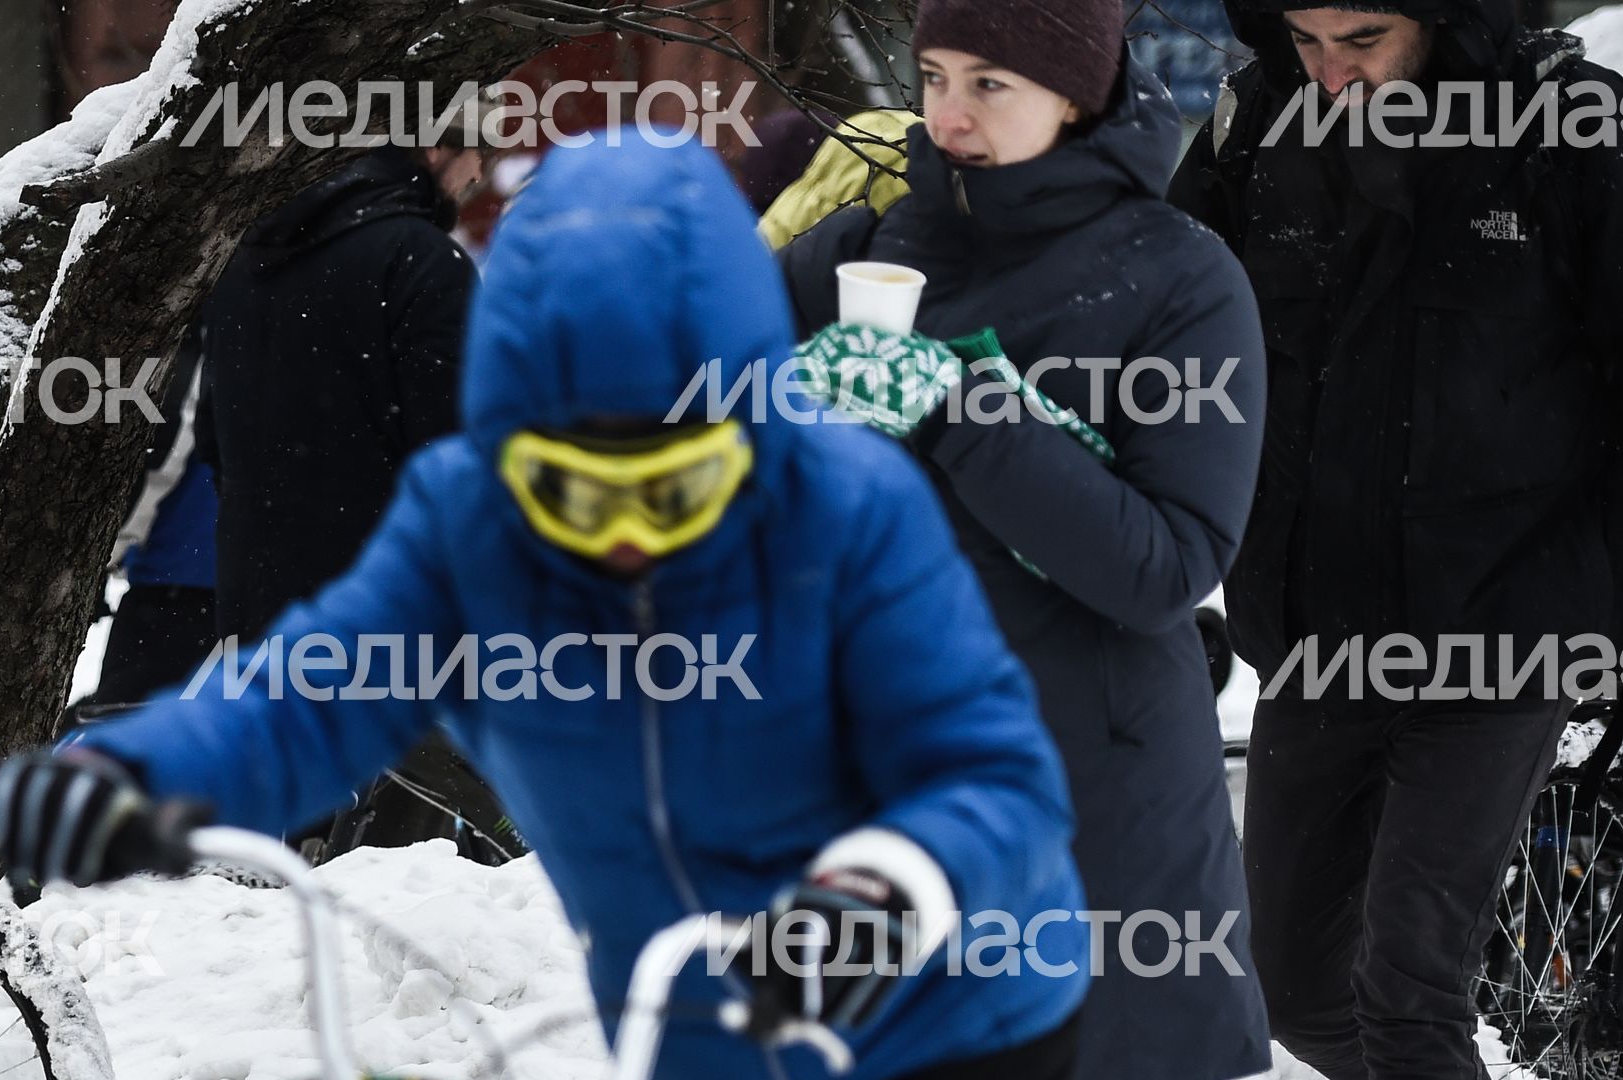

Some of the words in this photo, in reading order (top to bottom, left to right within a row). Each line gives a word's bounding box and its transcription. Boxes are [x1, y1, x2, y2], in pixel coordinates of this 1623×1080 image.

[1489, 210, 1511, 221] THE
[1470, 219, 1511, 230] NORTH
[1481, 229, 1511, 240] FACE
